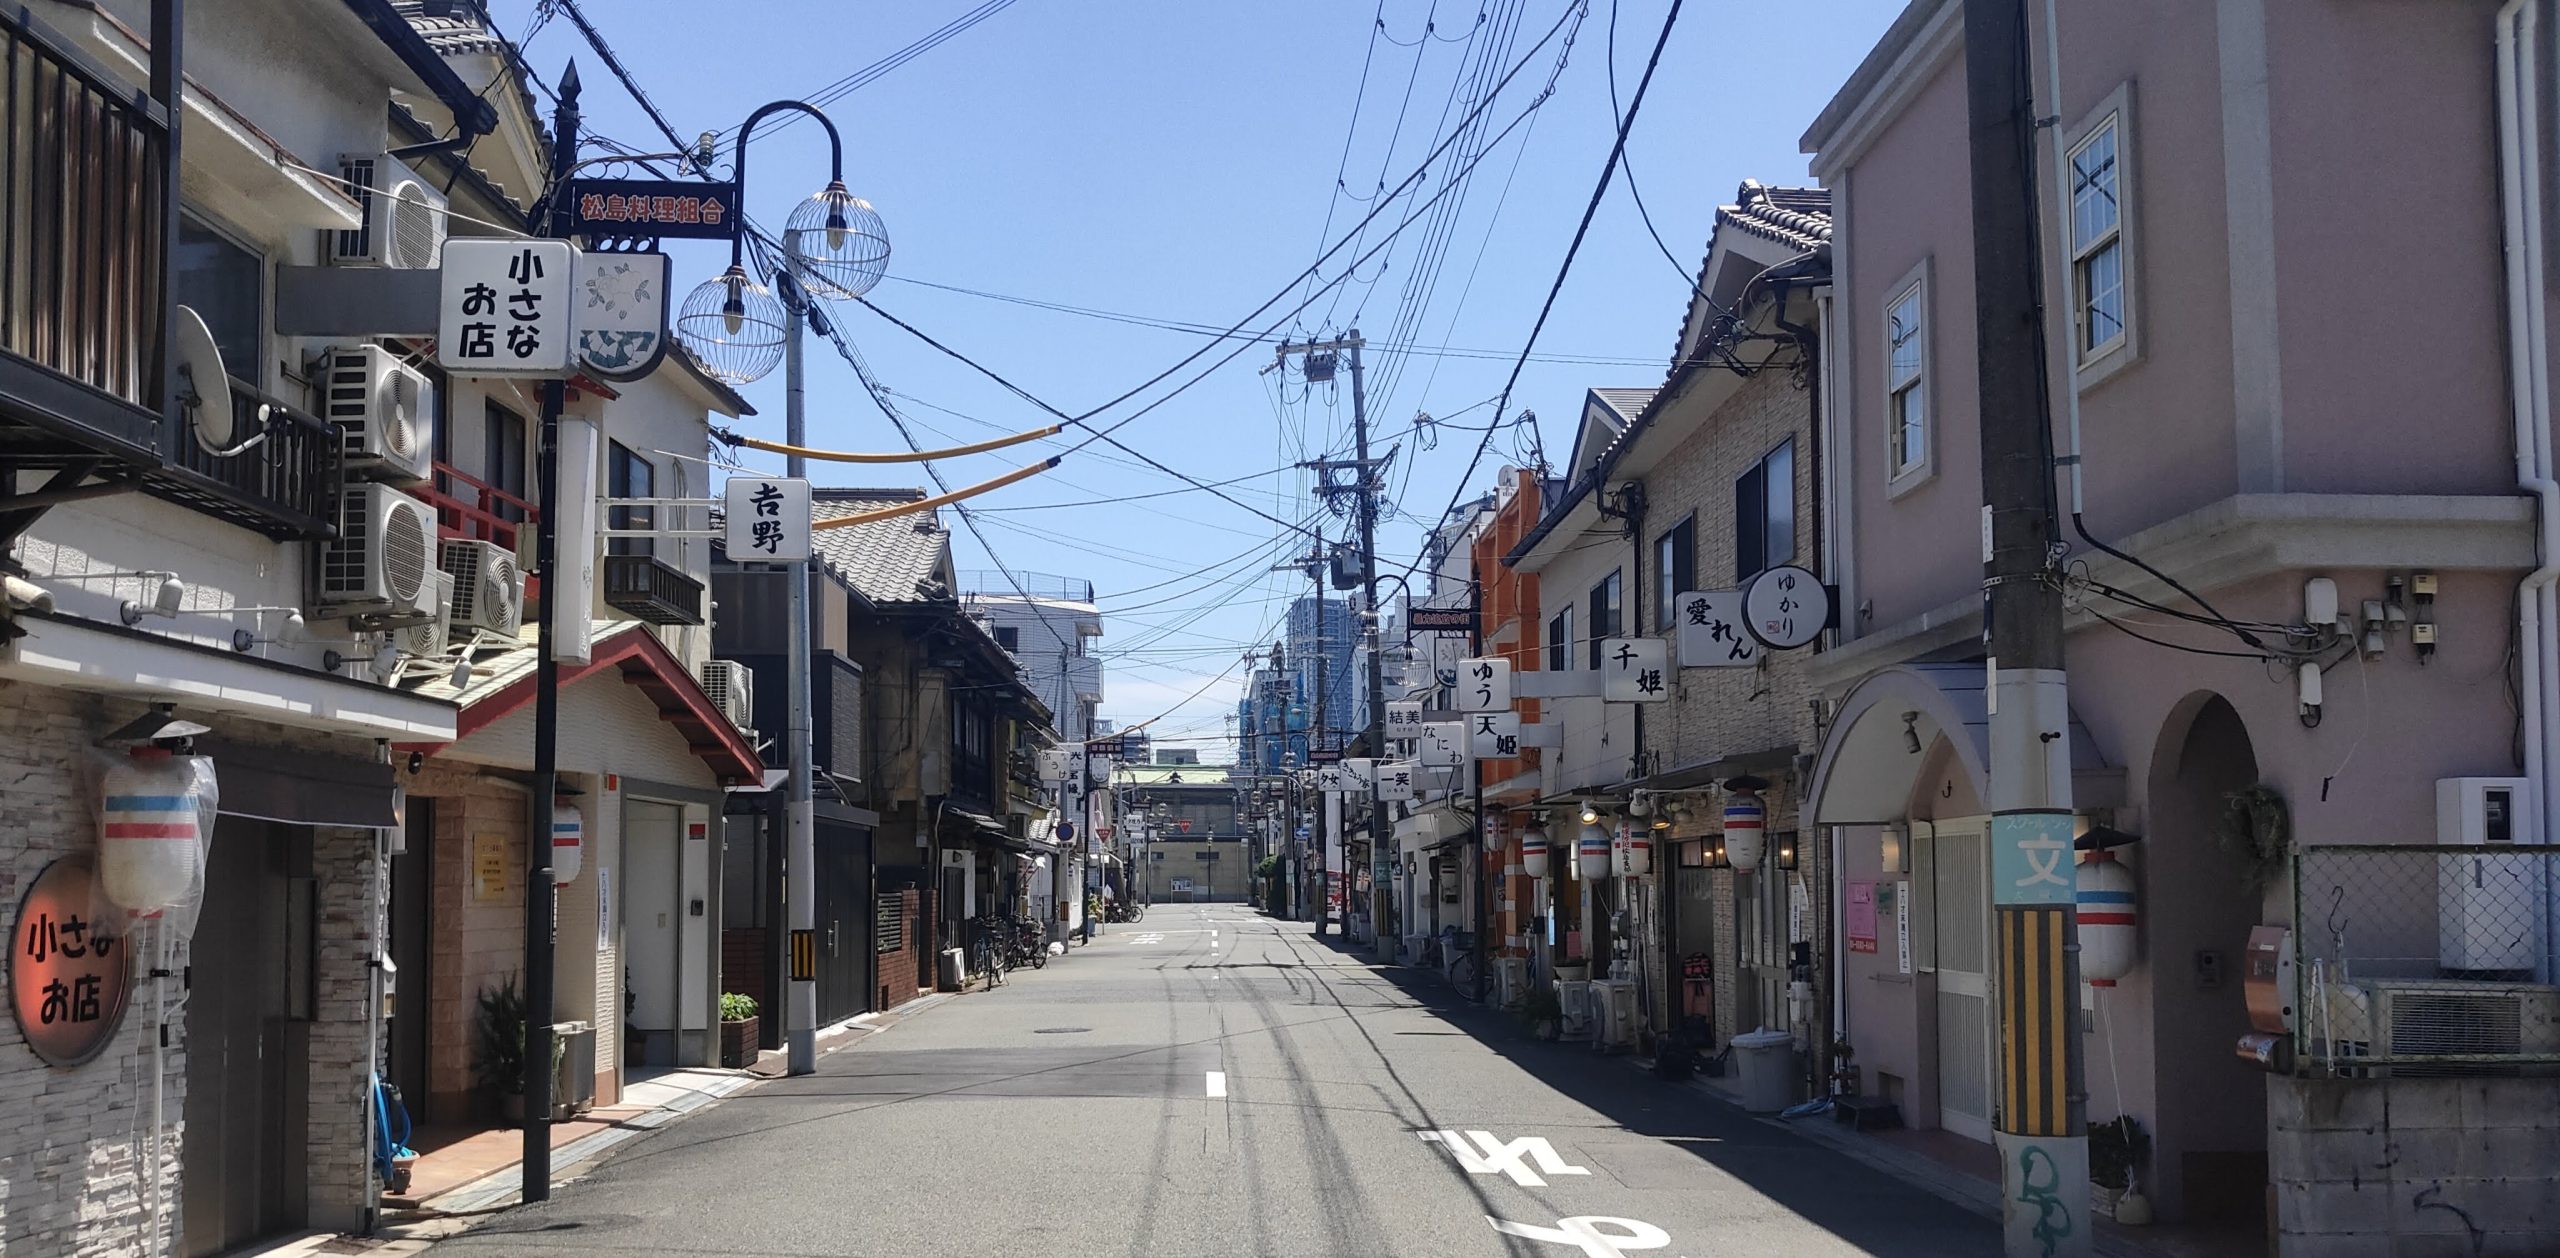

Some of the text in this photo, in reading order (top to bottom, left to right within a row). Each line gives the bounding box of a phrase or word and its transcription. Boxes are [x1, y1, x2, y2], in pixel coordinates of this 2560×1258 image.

[581, 194, 725, 225] 松島料理組合
[459, 283, 497, 358] お店
[506, 249, 544, 358] 小さな
[749, 482, 785, 554] 吉野
[1686, 598, 1753, 660] 愛れん
[1778, 573, 1799, 640] ゆかり
[1473, 662, 1493, 708] ゆう
[1612, 643, 1664, 696] 千姫
[1389, 710, 1421, 725] 結美
[1476, 716, 1517, 755] 天姫
[1423, 726, 1463, 764] なにわ
[1381, 772, 1410, 786] 一笑
[2016, 833, 2069, 886] 文
[41, 973, 101, 1024] お店
